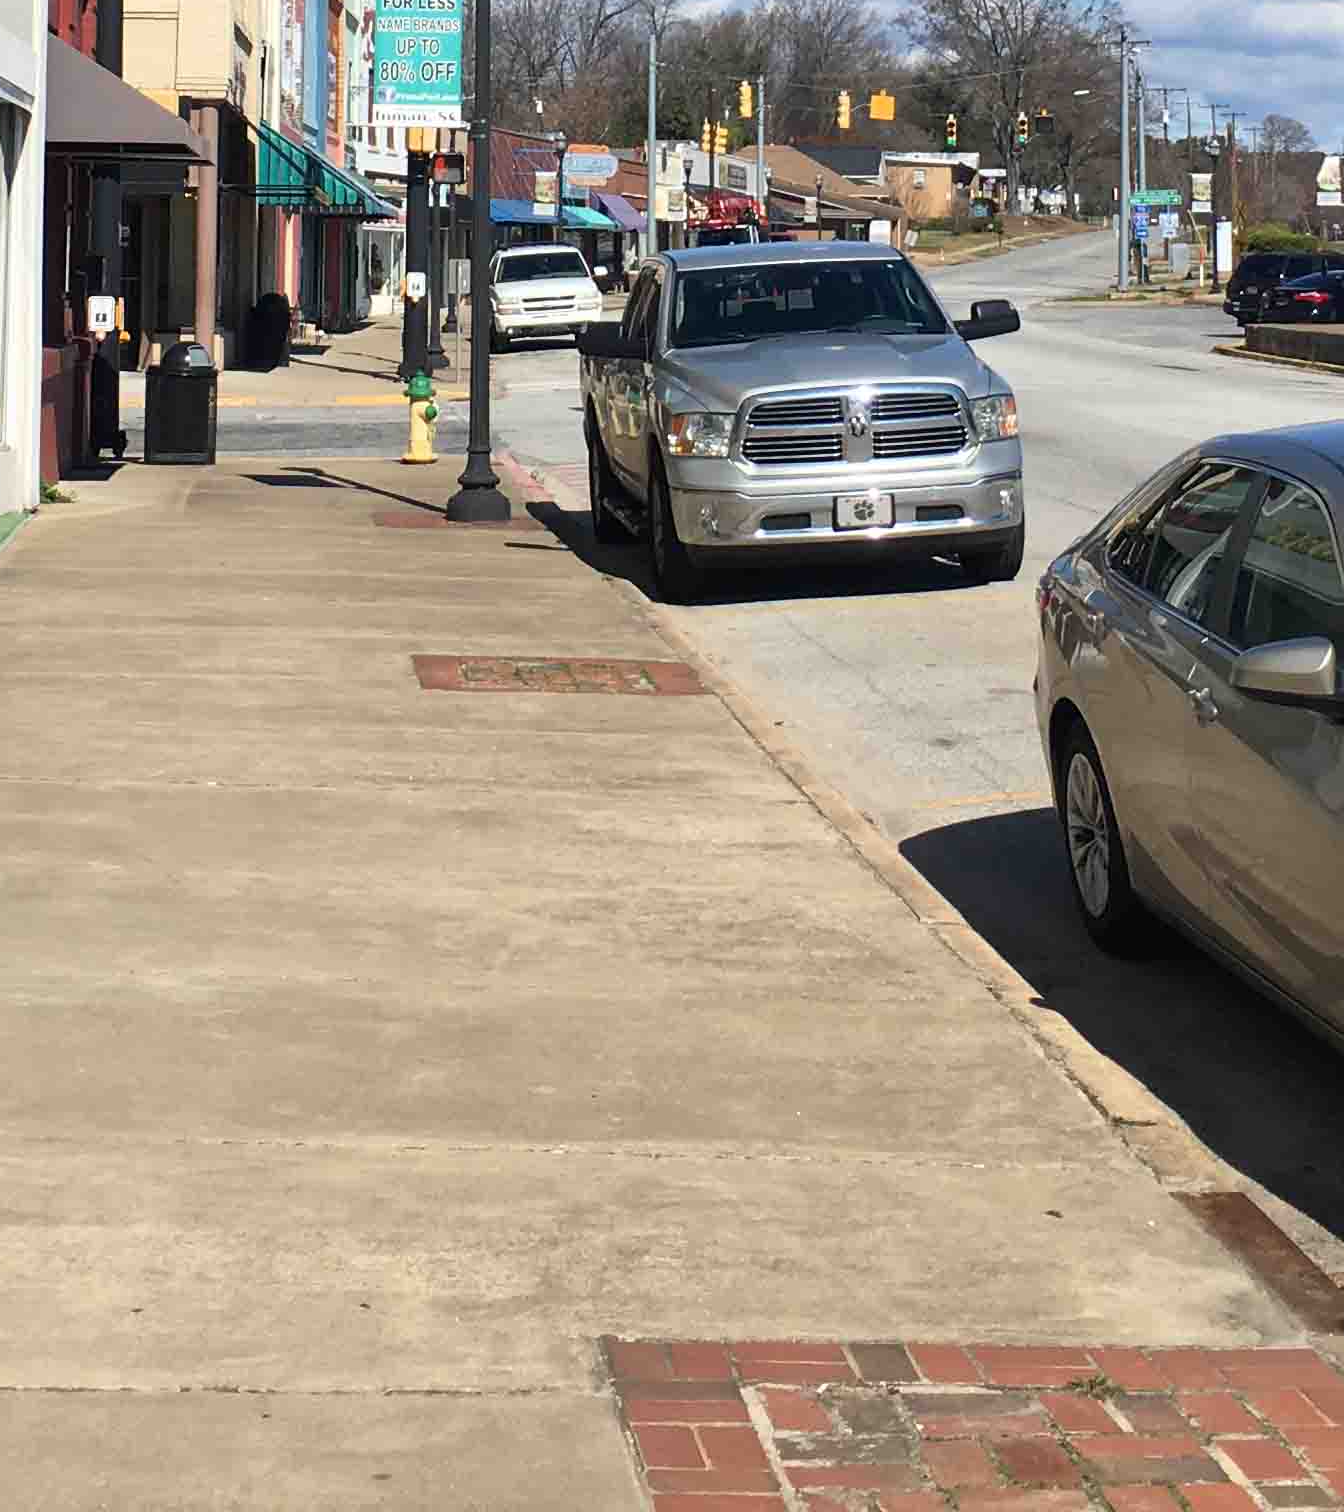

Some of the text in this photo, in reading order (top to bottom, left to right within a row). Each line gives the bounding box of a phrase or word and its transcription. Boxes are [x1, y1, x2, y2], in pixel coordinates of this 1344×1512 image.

[377, 18, 460, 32] NAME BRANDS
[395, 38, 440, 55] UP TO
[379, 62, 457, 82] 80% OFF
